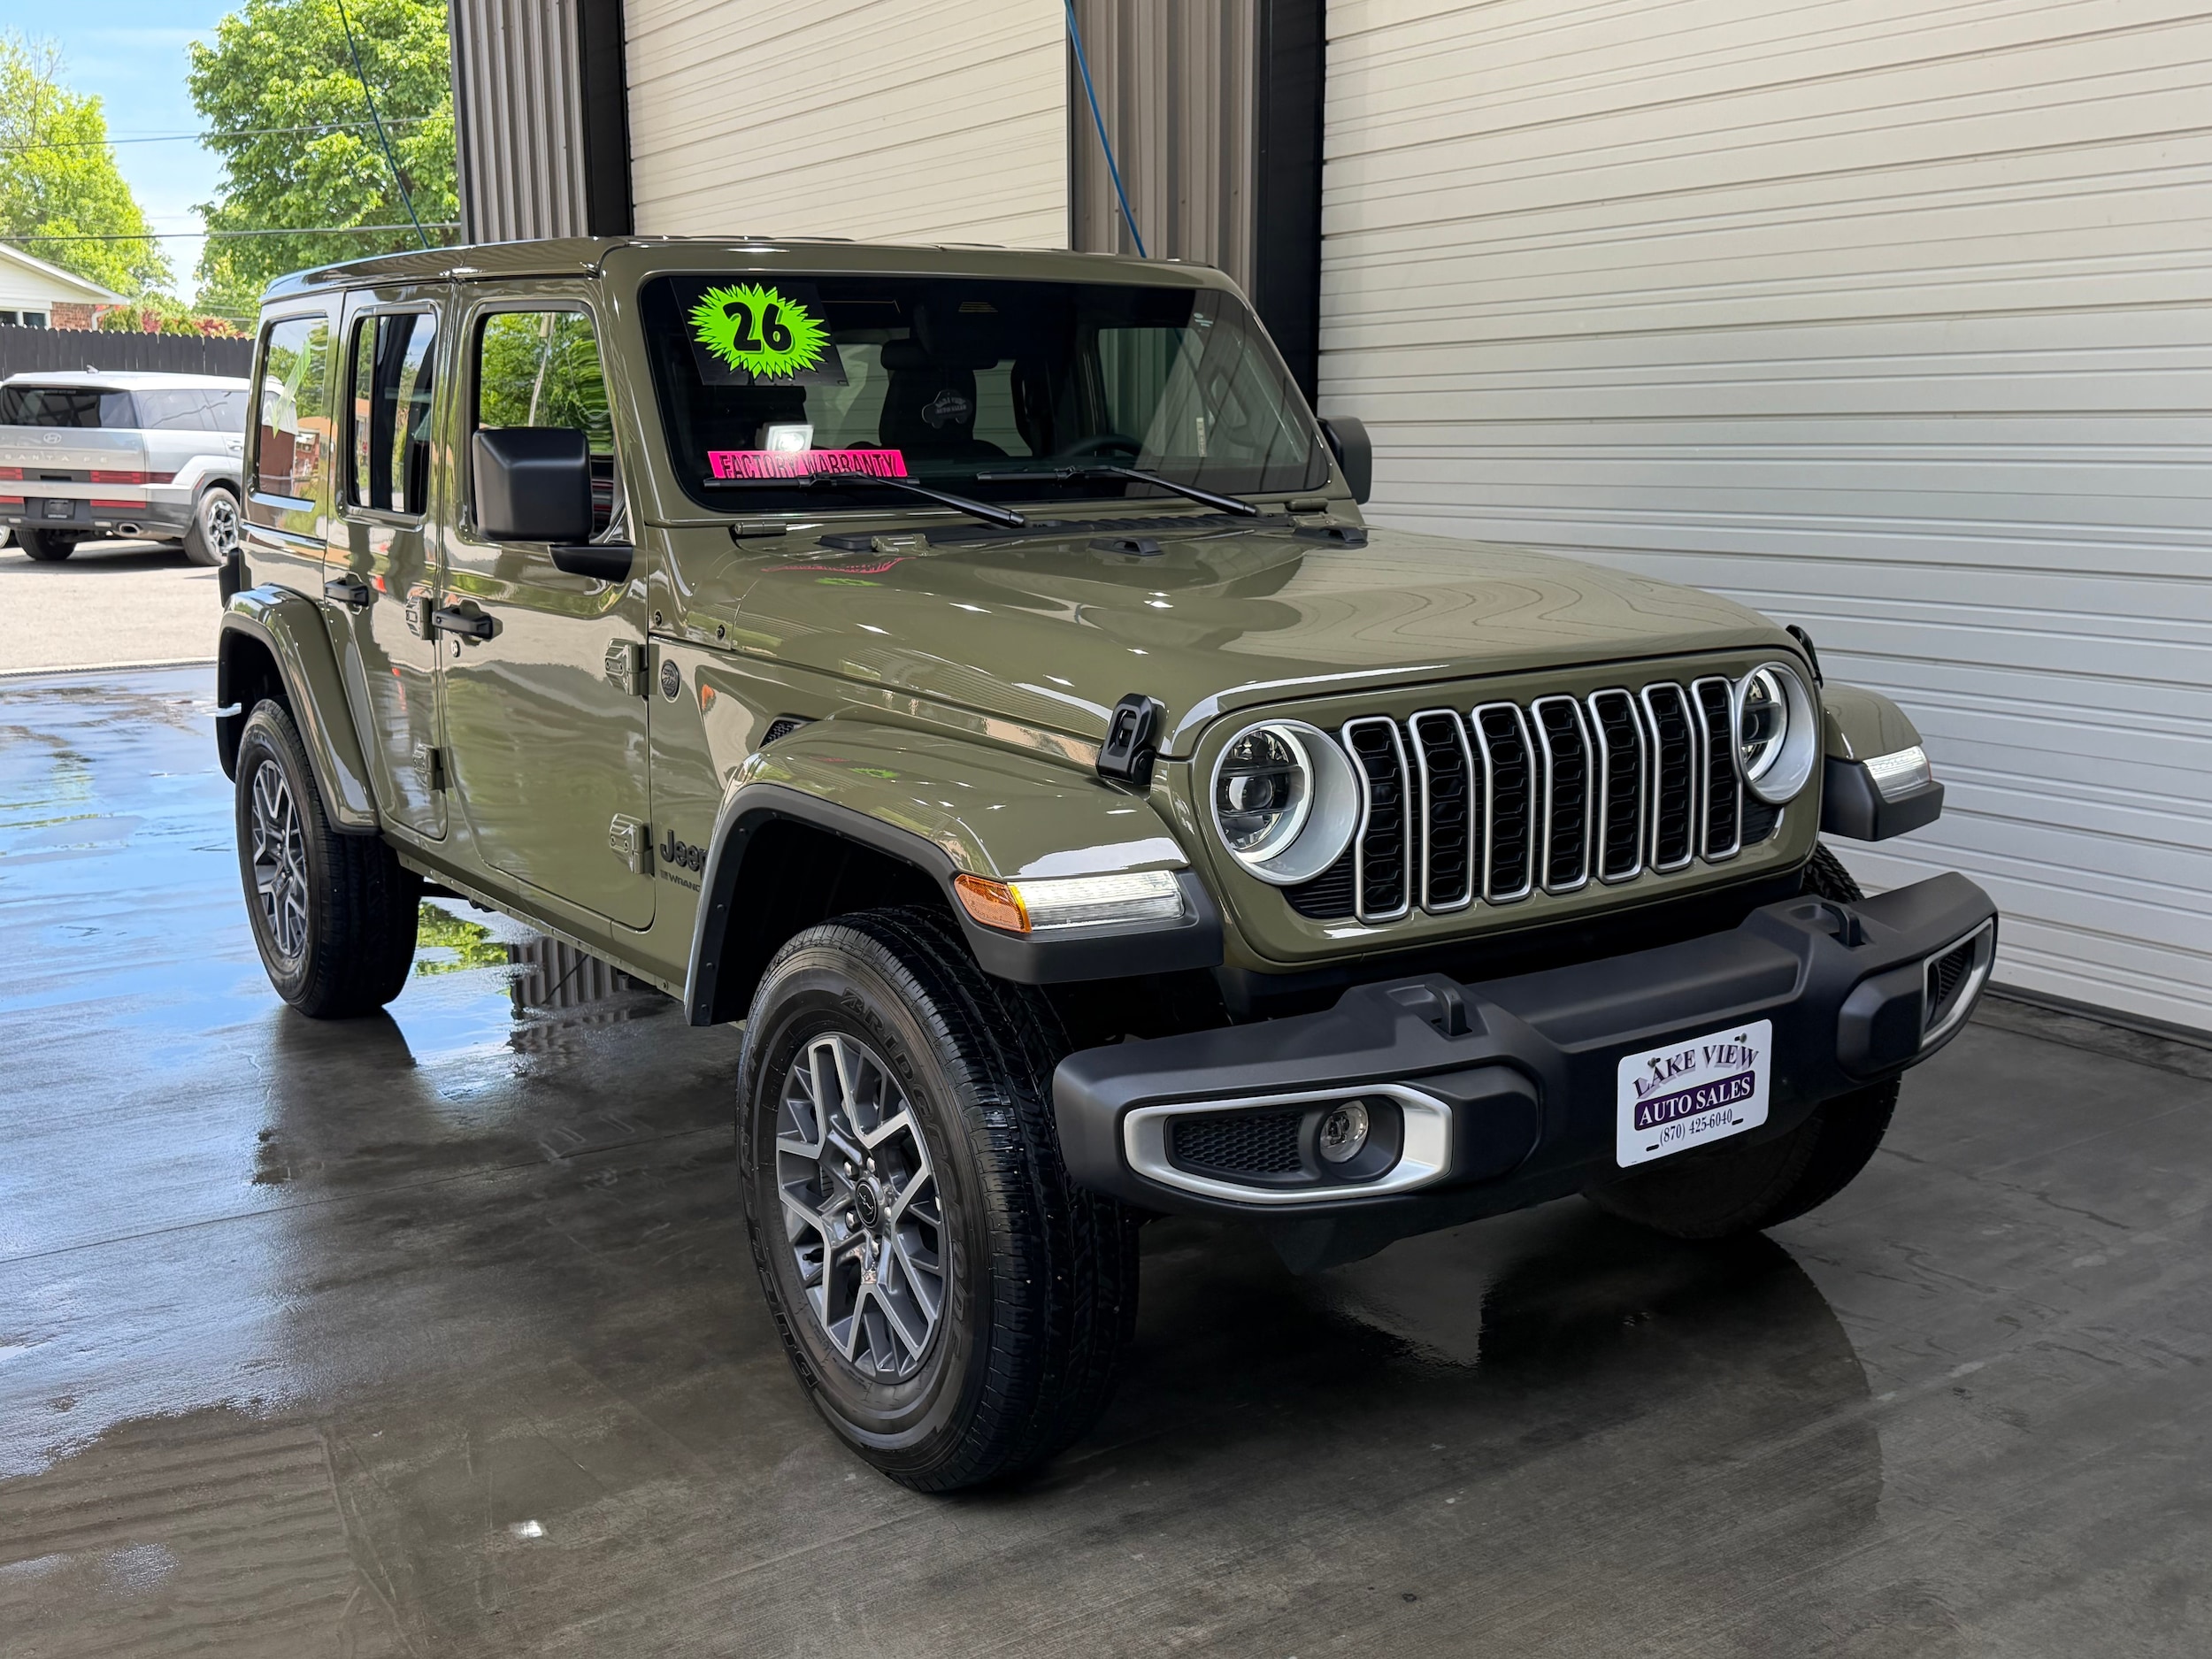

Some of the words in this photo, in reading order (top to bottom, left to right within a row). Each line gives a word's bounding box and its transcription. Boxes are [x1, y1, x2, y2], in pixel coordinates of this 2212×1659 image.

[723, 302, 794, 353] 26
[719, 454, 798, 478] FACTORY
[801, 454, 896, 476] WARRANTY
[1632, 1049, 1695, 1097] LAKE
[1702, 1045, 1759, 1071] VIEW
[1639, 1094, 1692, 1125] AUTO
[1696, 1077, 1750, 1110] SALES
[1660, 1122, 1686, 1147] (870)
[1689, 1109, 1732, 1134] 425-6040
